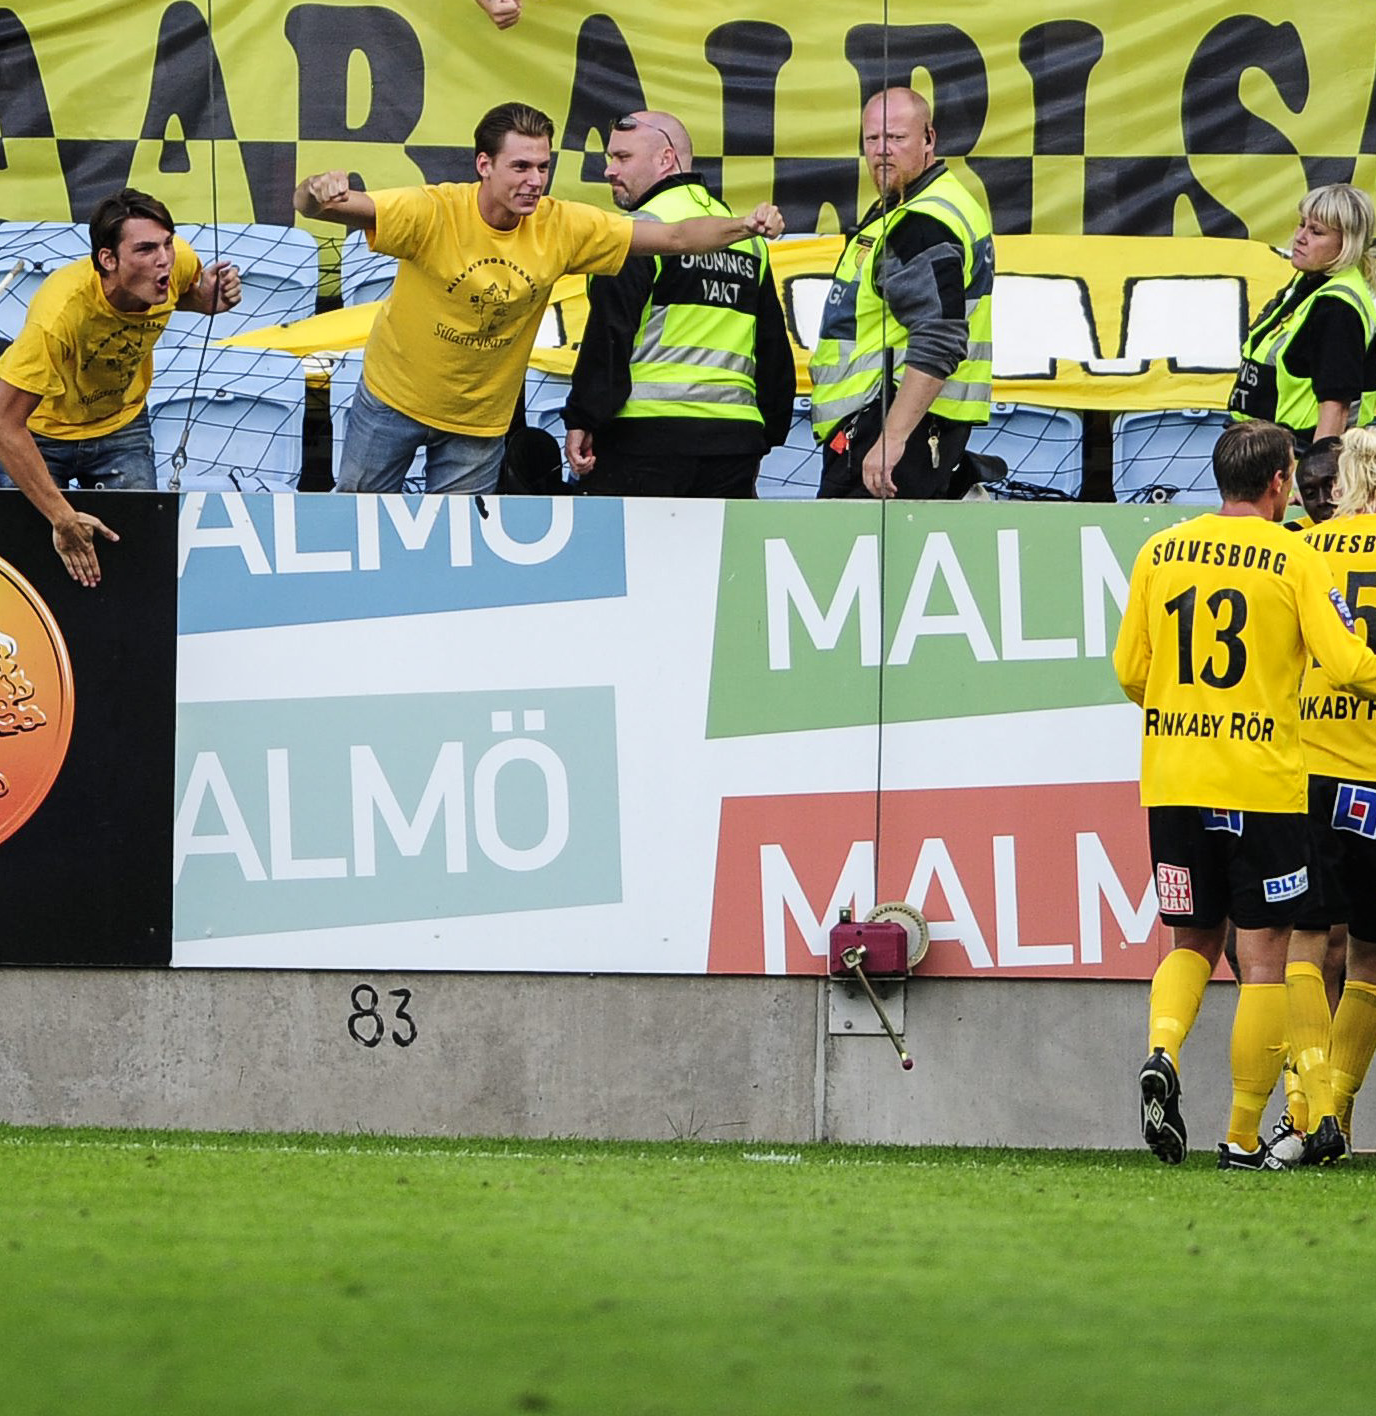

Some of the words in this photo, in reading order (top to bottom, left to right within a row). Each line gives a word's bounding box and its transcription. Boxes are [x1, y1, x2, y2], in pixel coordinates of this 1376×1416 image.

[1152, 538, 1287, 576] SÖLVESBORG
[1164, 585, 1248, 690] 13
[1145, 708, 1224, 738] RINKABY
[1230, 711, 1275, 743] RÖR
[347, 984, 417, 1048] 83
